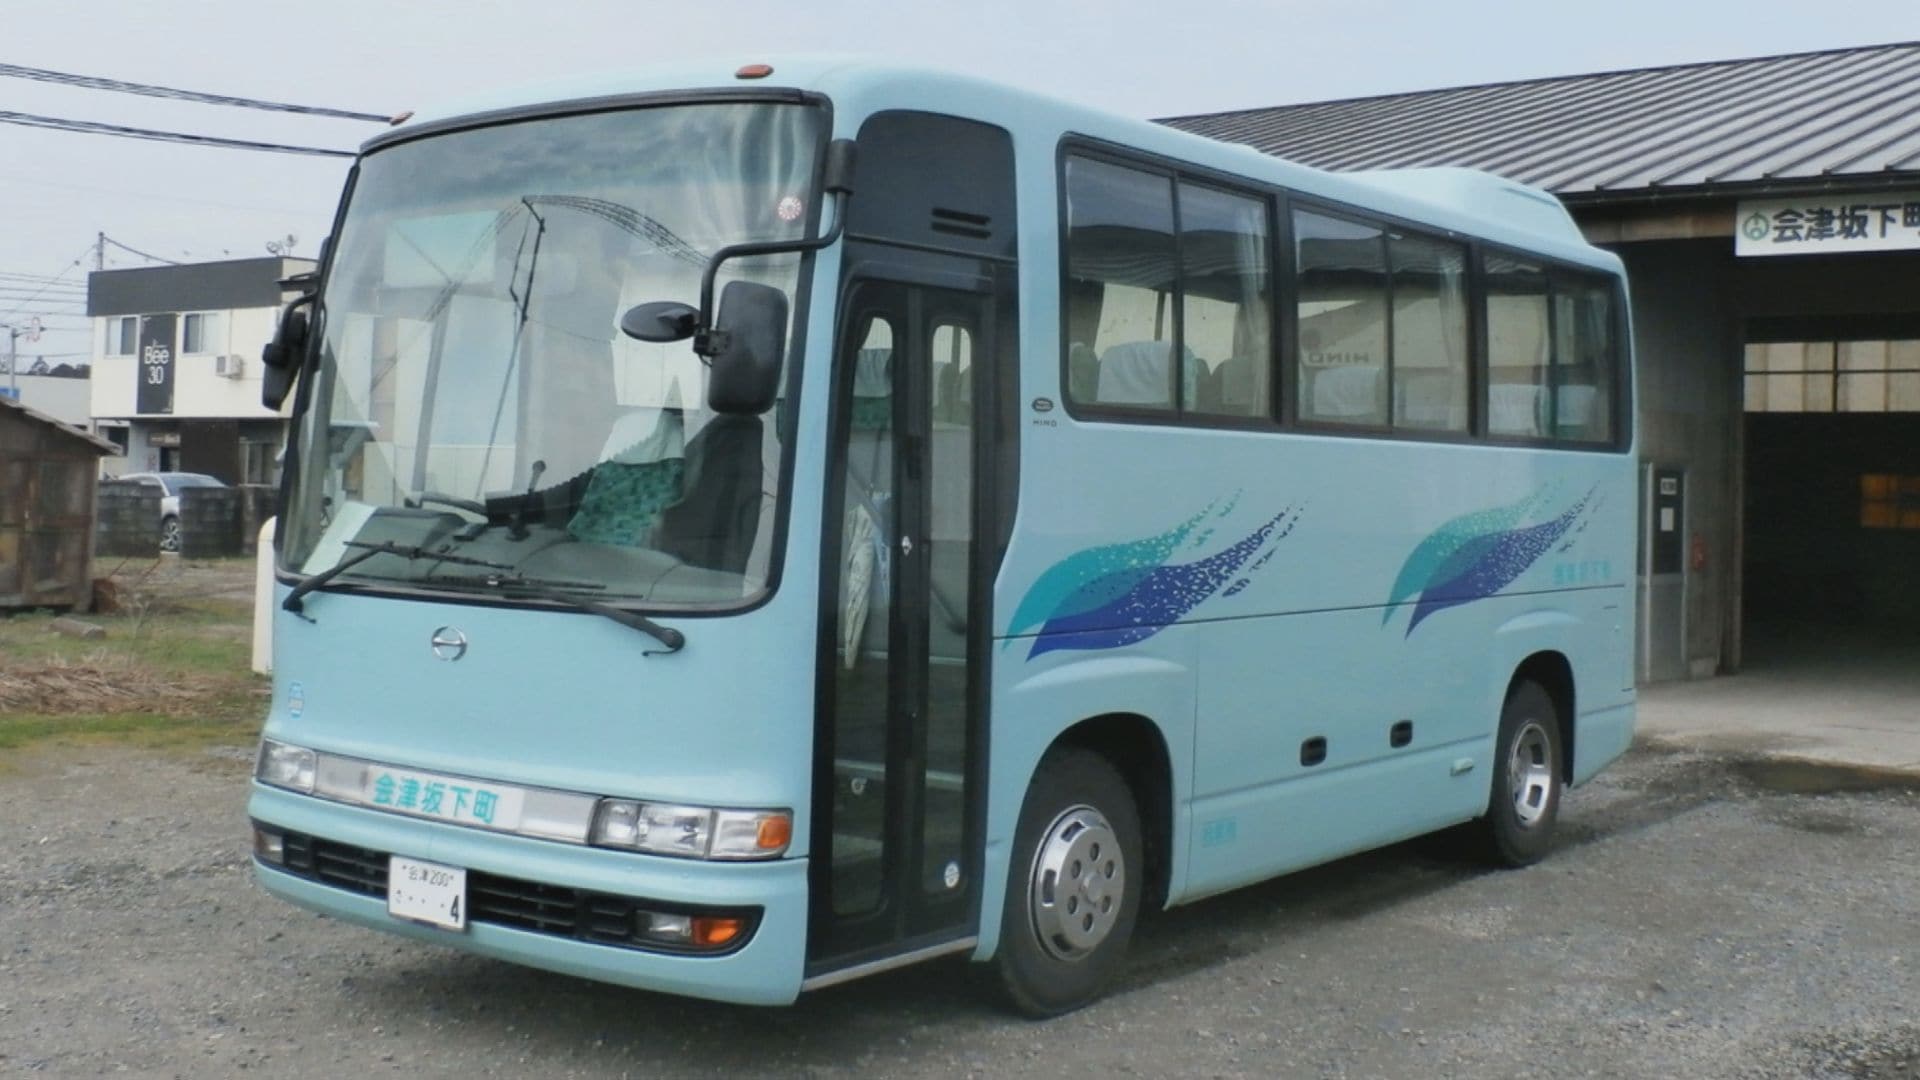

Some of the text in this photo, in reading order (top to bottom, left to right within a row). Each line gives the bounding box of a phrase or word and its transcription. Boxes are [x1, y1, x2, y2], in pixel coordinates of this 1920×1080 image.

[144, 345, 169, 364] Bee
[148, 366, 164, 384] 30
[373, 774, 498, 824] 会津坂下町
